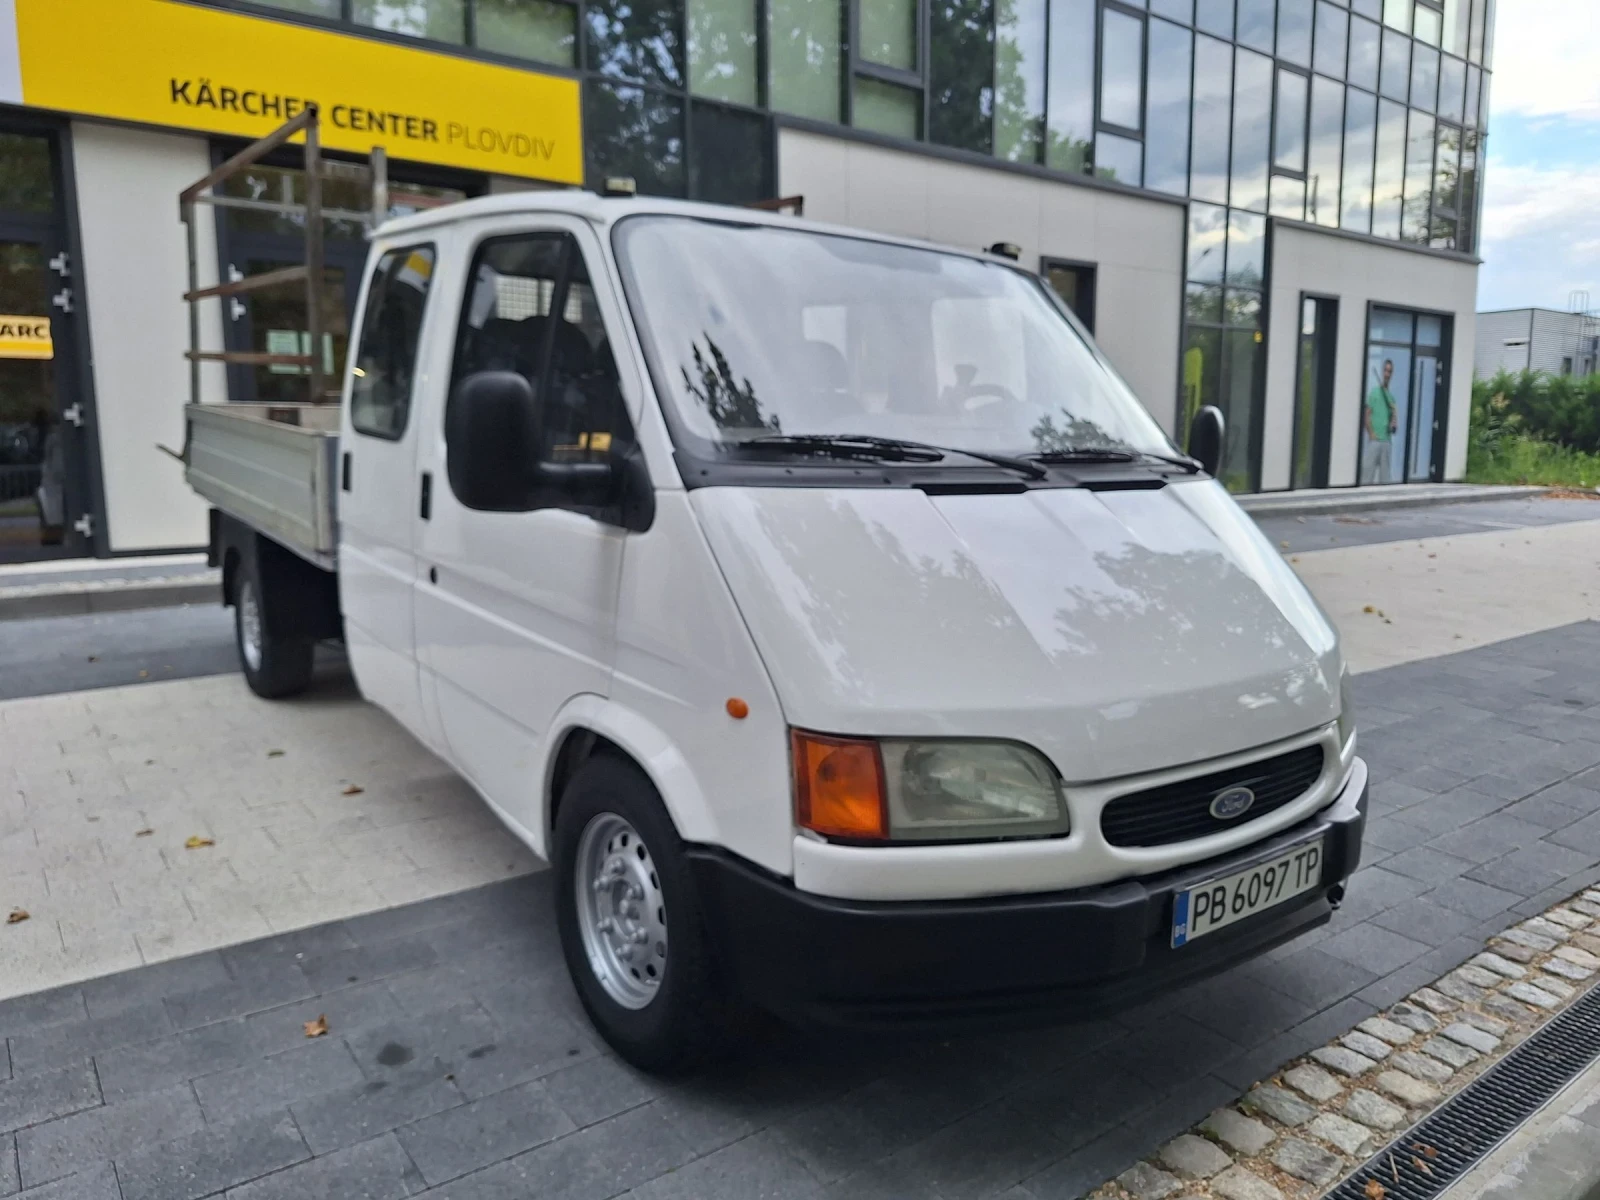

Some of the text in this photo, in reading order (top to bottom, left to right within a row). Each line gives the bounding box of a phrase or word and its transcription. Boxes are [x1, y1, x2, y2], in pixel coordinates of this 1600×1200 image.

[331, 104, 438, 142] CENTER
[446, 123, 555, 161] PLOVDIV
[1192, 847, 1319, 932] PB 6097 TP
